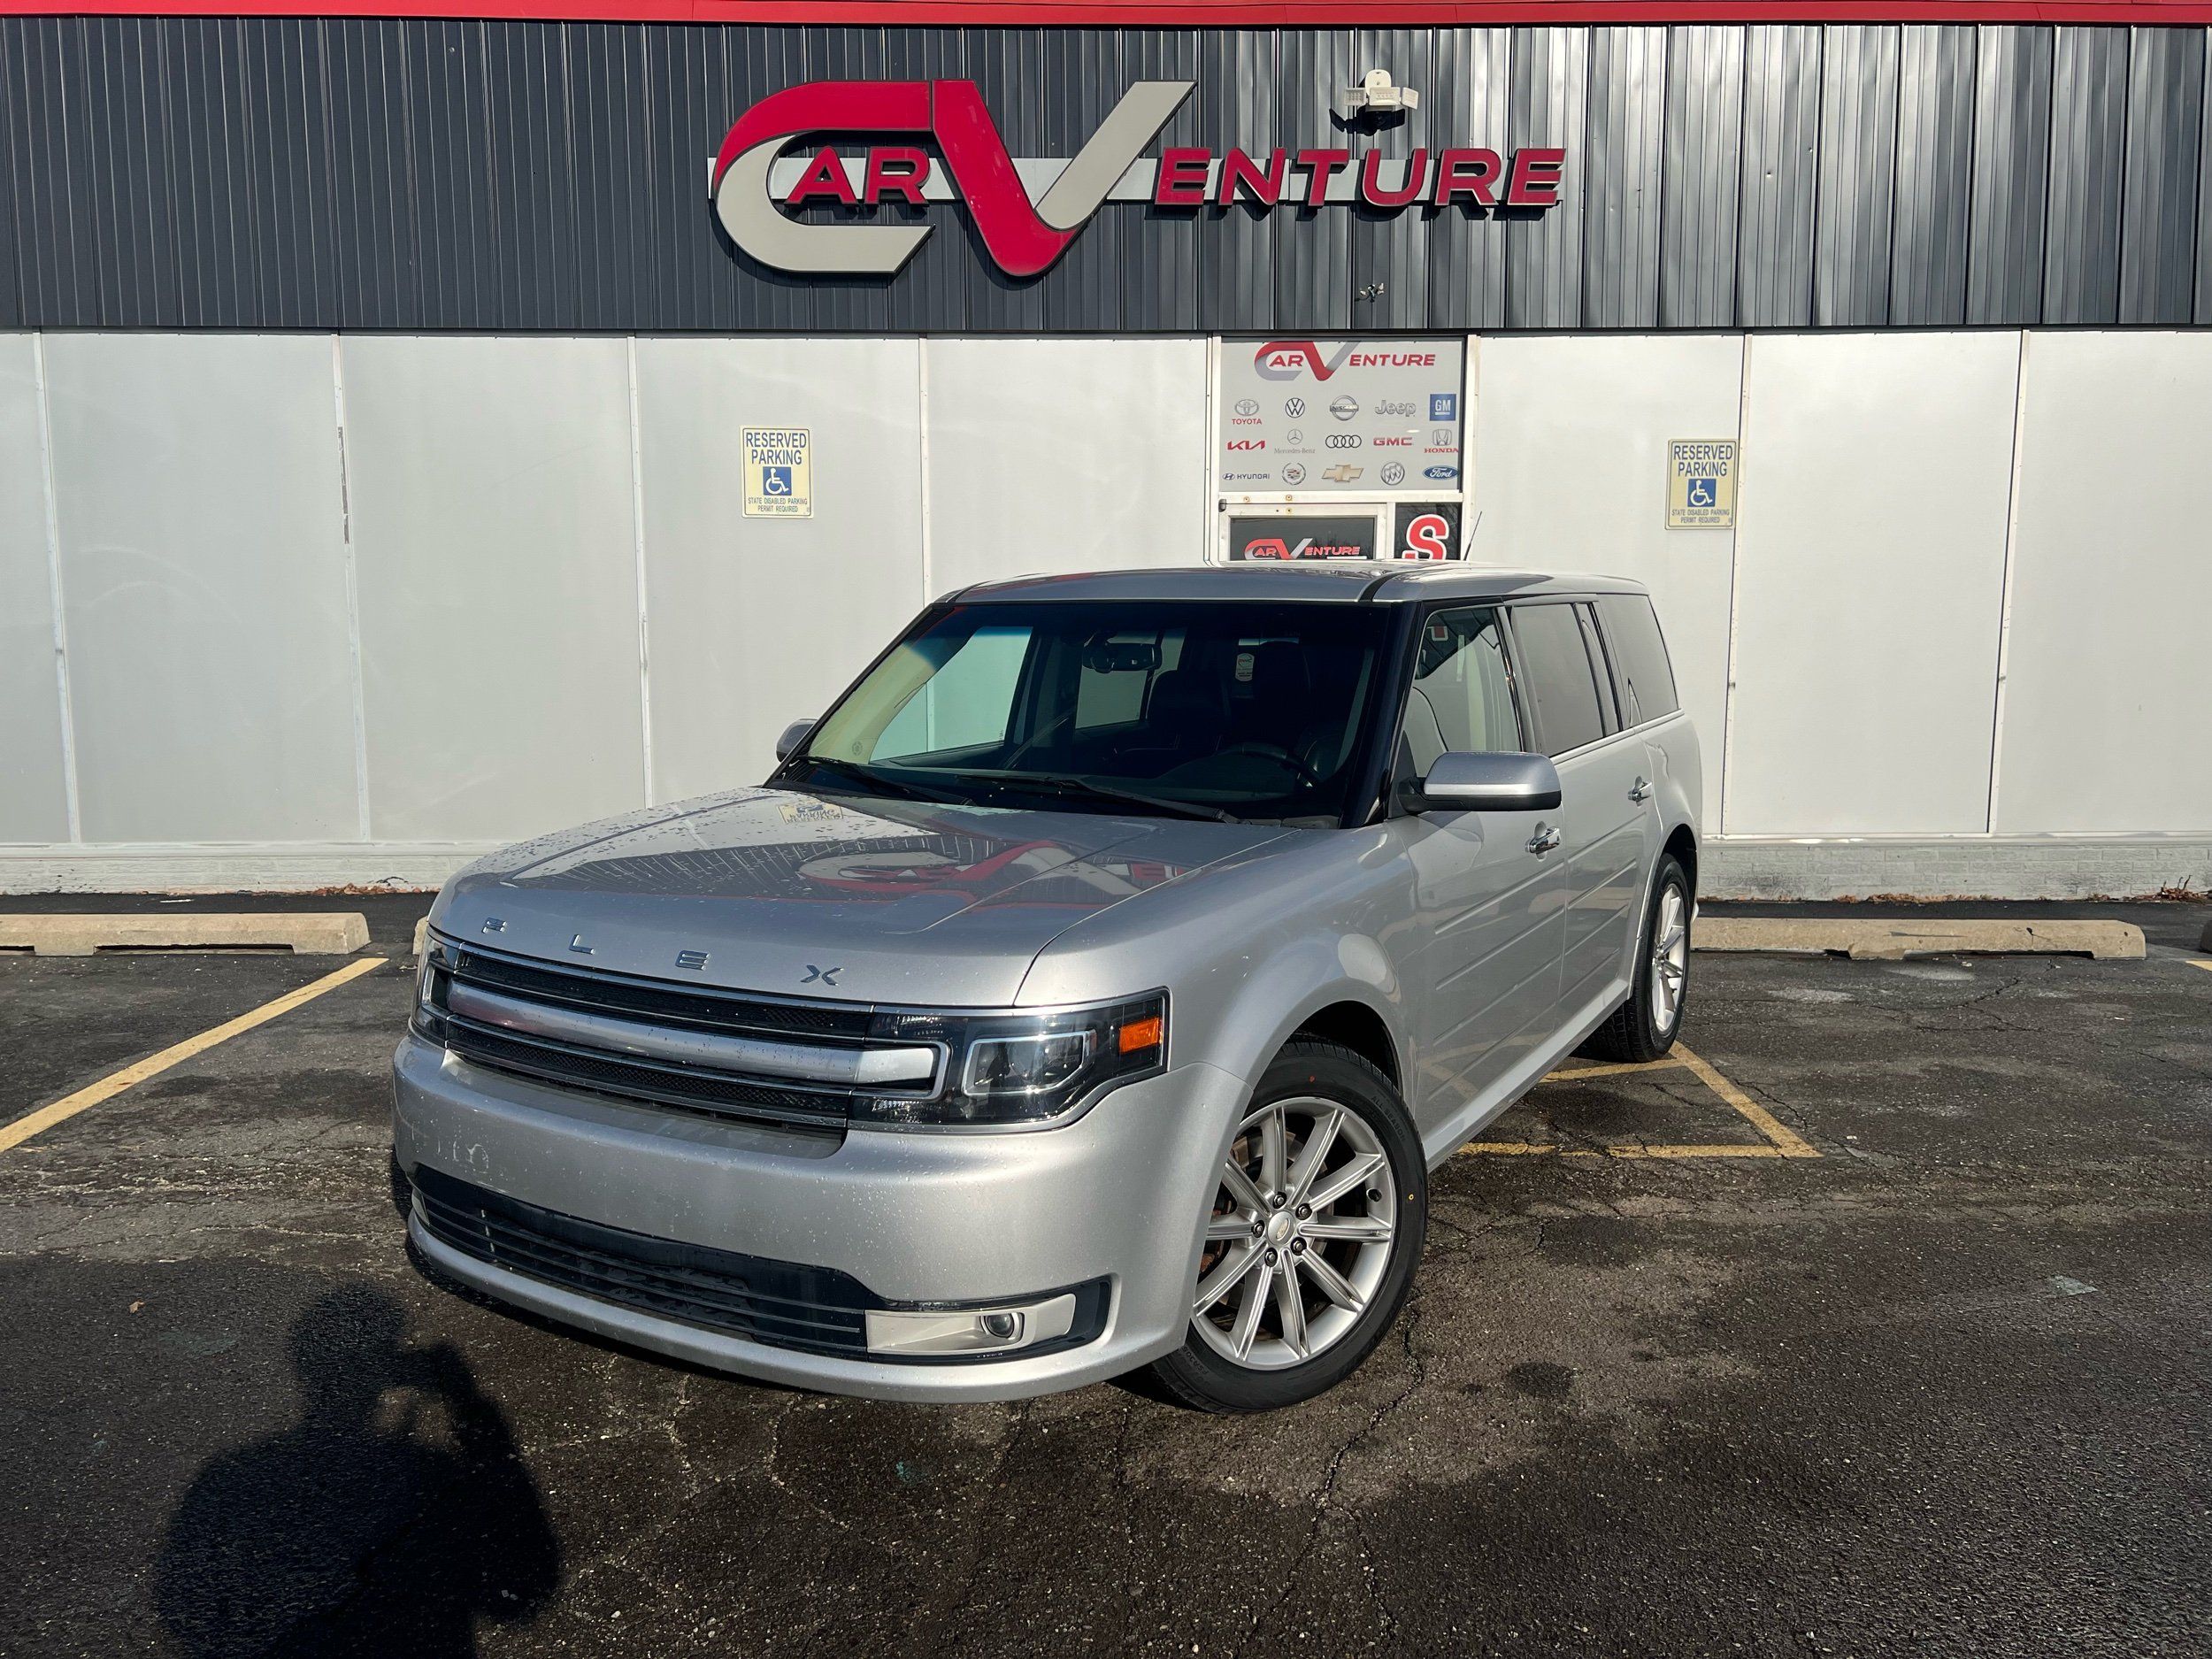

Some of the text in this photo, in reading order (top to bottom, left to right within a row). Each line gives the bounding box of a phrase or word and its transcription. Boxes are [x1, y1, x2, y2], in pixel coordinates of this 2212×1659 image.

[1375, 400, 1416, 417] Jeep
[1435, 399, 1451, 411] GM
[746, 432, 807, 448] RESERVED
[1226, 441, 1265, 450] KIA
[1373, 437, 1413, 446] GMC
[751, 449, 803, 465] PARKING
[1673, 445, 1733, 460] RESERVED
[1678, 462, 1727, 477] PARKING
[481, 917, 845, 986] FLEX
